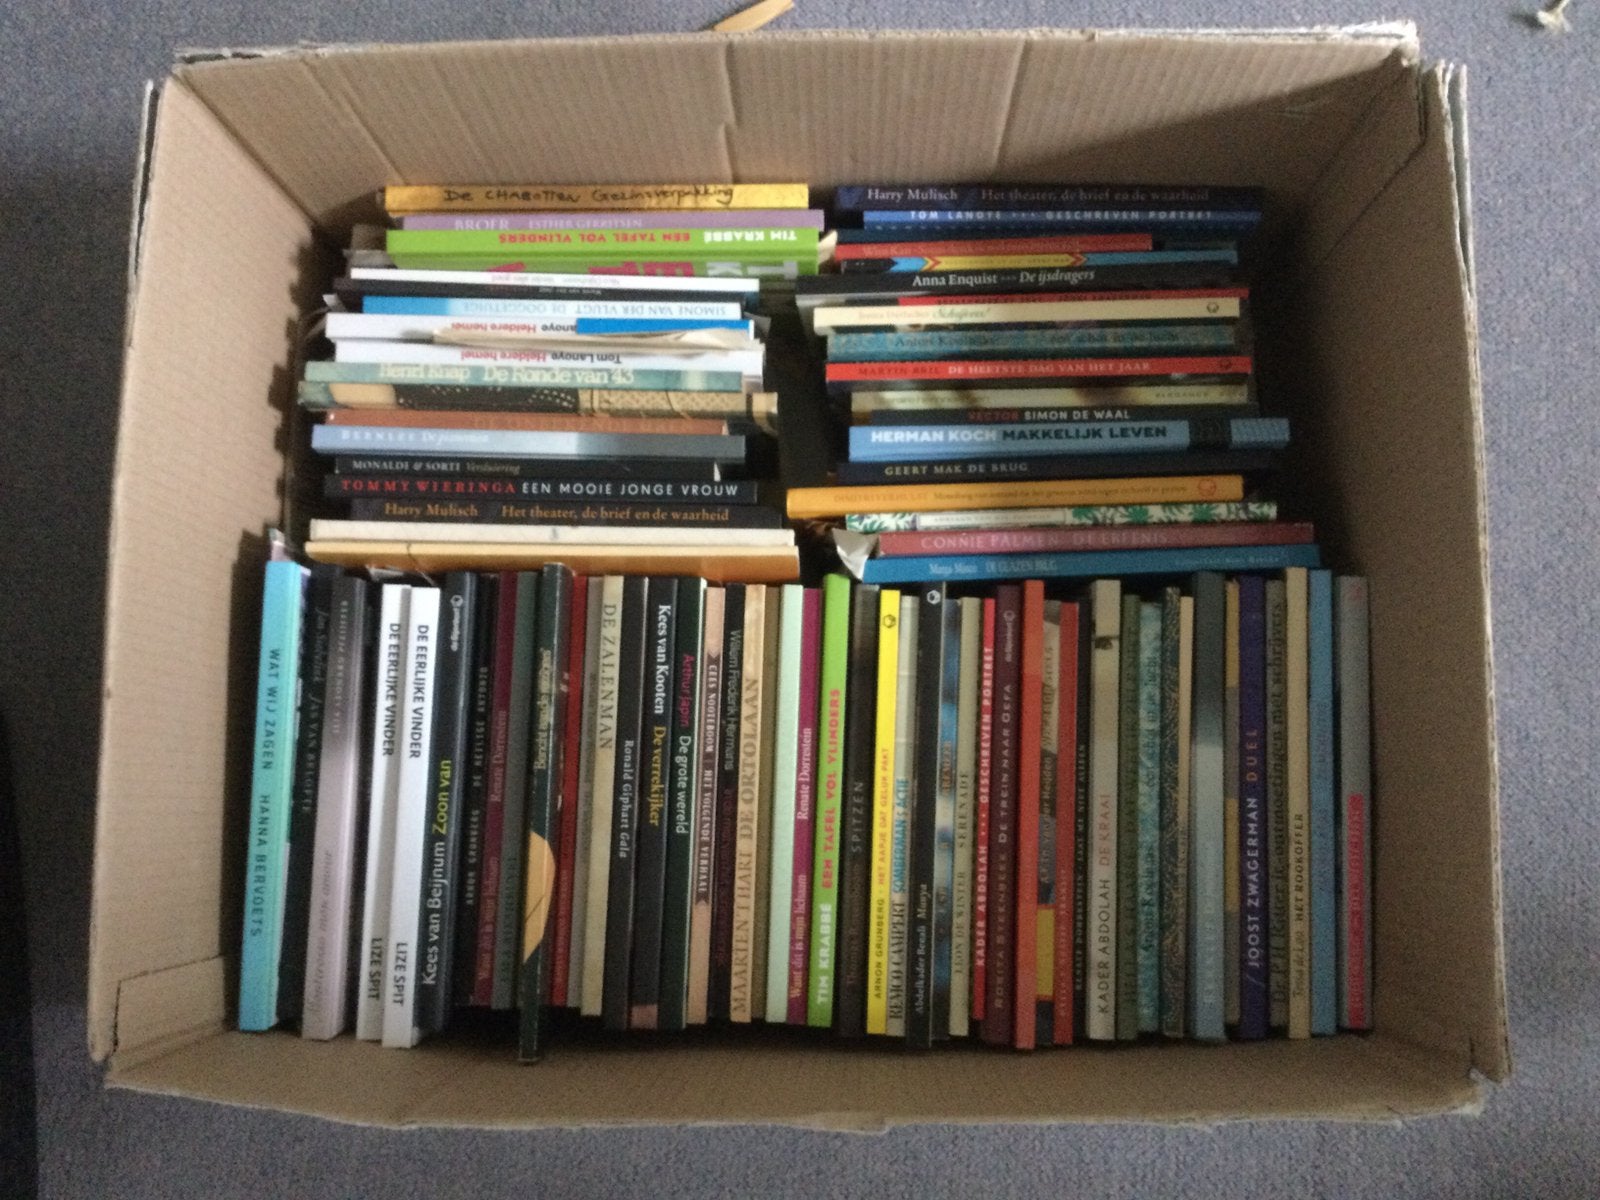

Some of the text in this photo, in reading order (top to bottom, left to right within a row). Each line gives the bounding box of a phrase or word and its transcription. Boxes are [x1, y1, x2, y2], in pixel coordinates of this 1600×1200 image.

[443, 189, 474, 203] De
[867, 187, 959, 203] Harry Mulisch
[910, 210, 939, 220] TOM
[497, 229, 798, 244] TIM KRABBÉ EEN TAFEL VOL VLINDERS
[912, 268, 1096, 289] Anna Enquist De ijsdragers
[574, 302, 618, 315] VLUGT
[621, 303, 645, 315] DER
[647, 303, 674, 315] VAN
[677, 304, 727, 316] SIMONE
[490, 321, 537, 334] Heldere
[460, 349, 623, 364] Tom Lanoye Heldere hemel
[483, 365, 608, 385] De Ronde van
[948, 365, 964, 375] DE
[1058, 363, 1084, 373] VAN
[1089, 362, 1114, 372] HET
[1023, 409, 1131, 421] SIMON DE WAAL
[870, 425, 1167, 444] HERMAN KOCH MAKKELIJK LEVEN
[352, 459, 410, 471] MONALDI
[884, 462, 1029, 477] GEERT MAK DE BRUG
[340, 478, 740, 497] TOMMY WIERINGA EEN MOOIE JONGE VROUW
[383, 502, 730, 522] Harry Mulisch Het theater, de brief en de waarheid
[920, 532, 1059, 550] CONNIE PALMEN
[599, 603, 618, 751] DE ZALENMAN
[647, 604, 672, 827] Kees van Kooten De verrekijker
[674, 654, 695, 835] Arthur De grote wereld
[1001, 728, 1010, 769] NAAR
[881, 747, 890, 772] PAKT
[698, 664, 718, 894] CEES NOOTEBOOM HET VOLGENDE VERHAAL
[796, 727, 812, 820] Renate Dorrestein
[250, 648, 282, 939] WAT WIJ ZAGEN HANNA BERVOETS
[618, 739, 635, 859] Ronald Giphart Gala
[366, 622, 402, 1001] DE EERLIJKE VINDER LIZE SPIT
[391, 624, 430, 1007] DE EERLIJKE VINDER LIZE SPIT
[850, 780, 865, 854] SPITZEN
[976, 645, 993, 967] KADER ABDOLAH GESCHREVEN PORTRET
[732, 676, 759, 1014] MAARTEN HART DE ORTOLAAN
[998, 823, 1008, 844] DE
[816, 688, 841, 1005] TIM KRABBÉ EEN TAFEL VOL VLINDERS
[1246, 728, 1261, 968] JOOST ZWAGERMAN DUEL
[422, 759, 452, 985] Kees van Beijnum Zoon van
[877, 866, 886, 886] HET
[1294, 813, 1304, 922] HET ROOKOFFER
[1096, 793, 1112, 1015] KADER ABDOLAH DE KRAAI
[874, 898, 886, 958] GRUNBERG
[873, 961, 884, 999] ARNON
[888, 968, 903, 1020] REMCO
